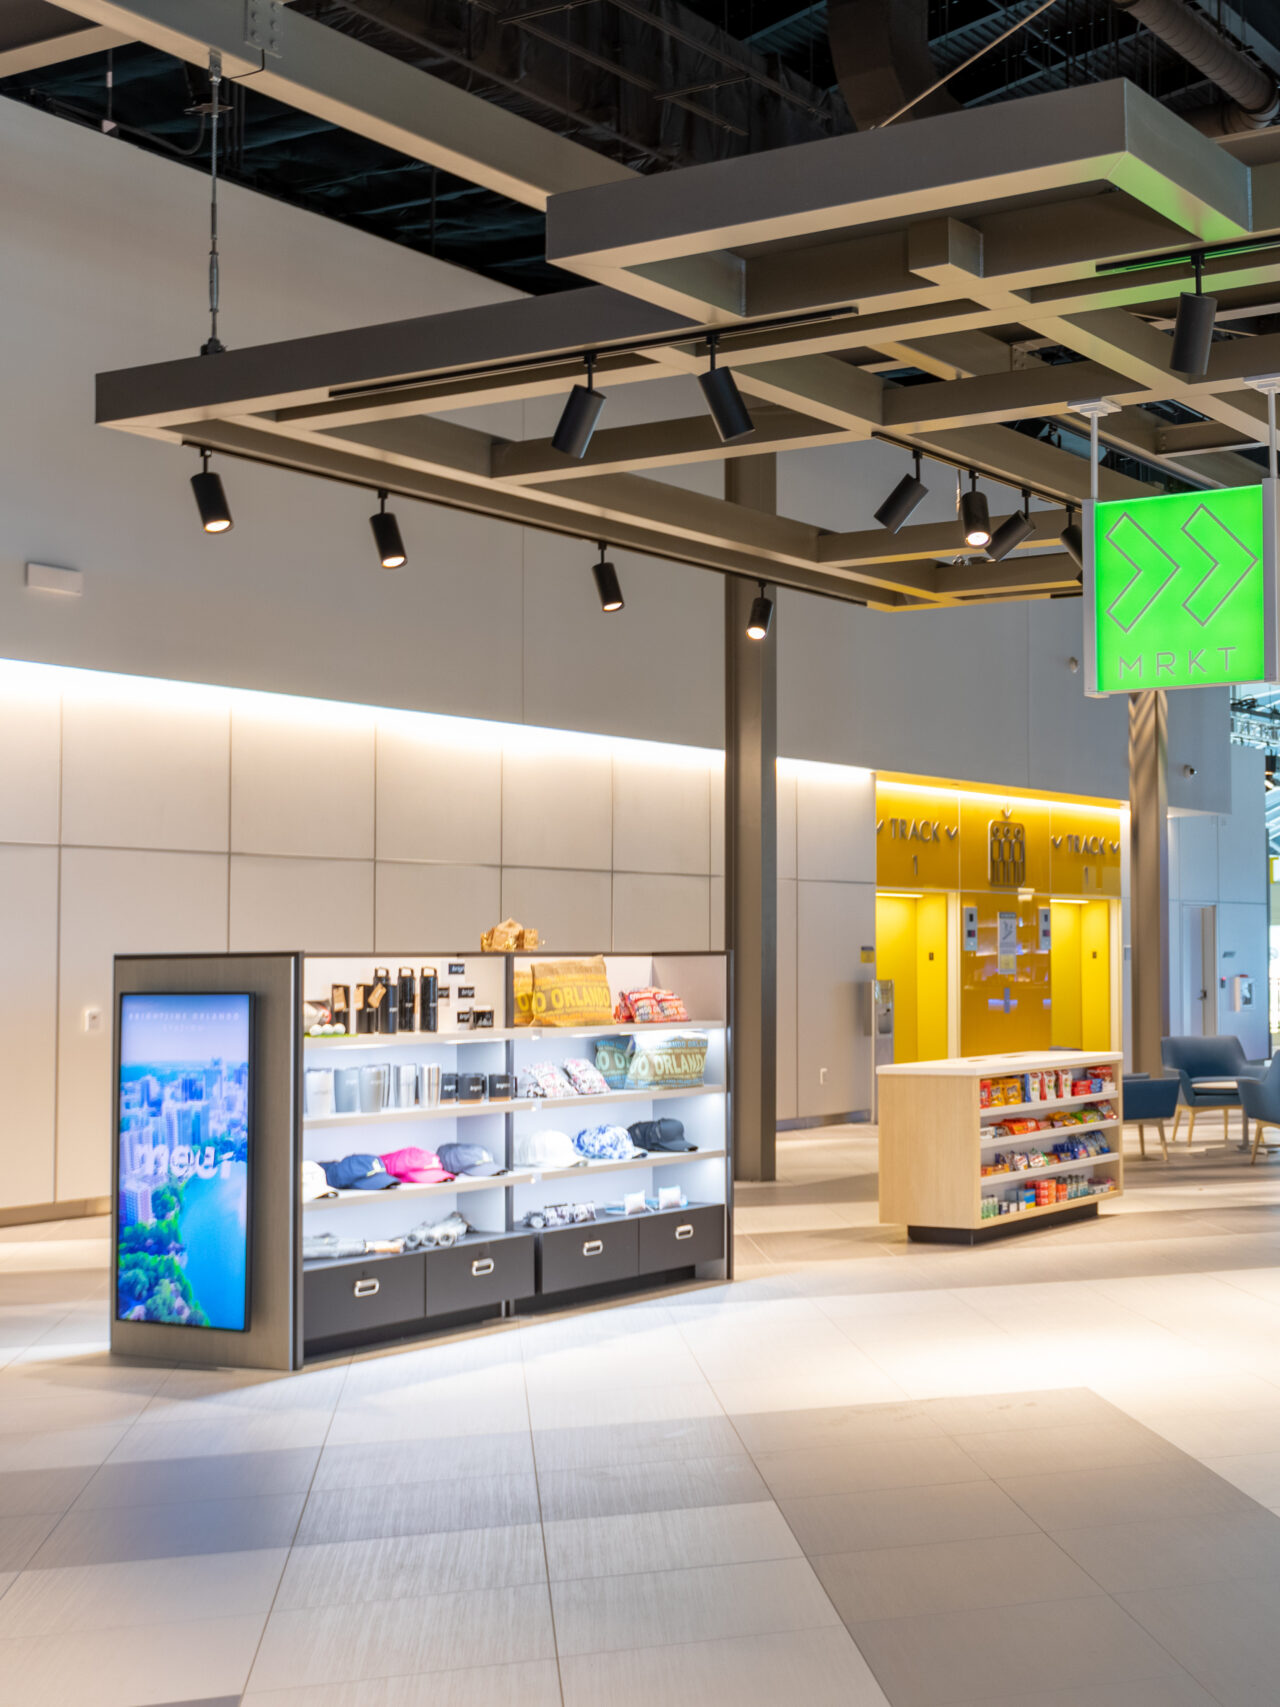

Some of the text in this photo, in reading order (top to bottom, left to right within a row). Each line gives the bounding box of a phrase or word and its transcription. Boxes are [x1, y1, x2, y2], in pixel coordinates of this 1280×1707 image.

[1119, 647, 1237, 679] MRKT
[890, 818, 941, 842] TRACK
[1067, 834, 1106, 855] TRACK
[551, 986, 610, 1010] ORLANDO
